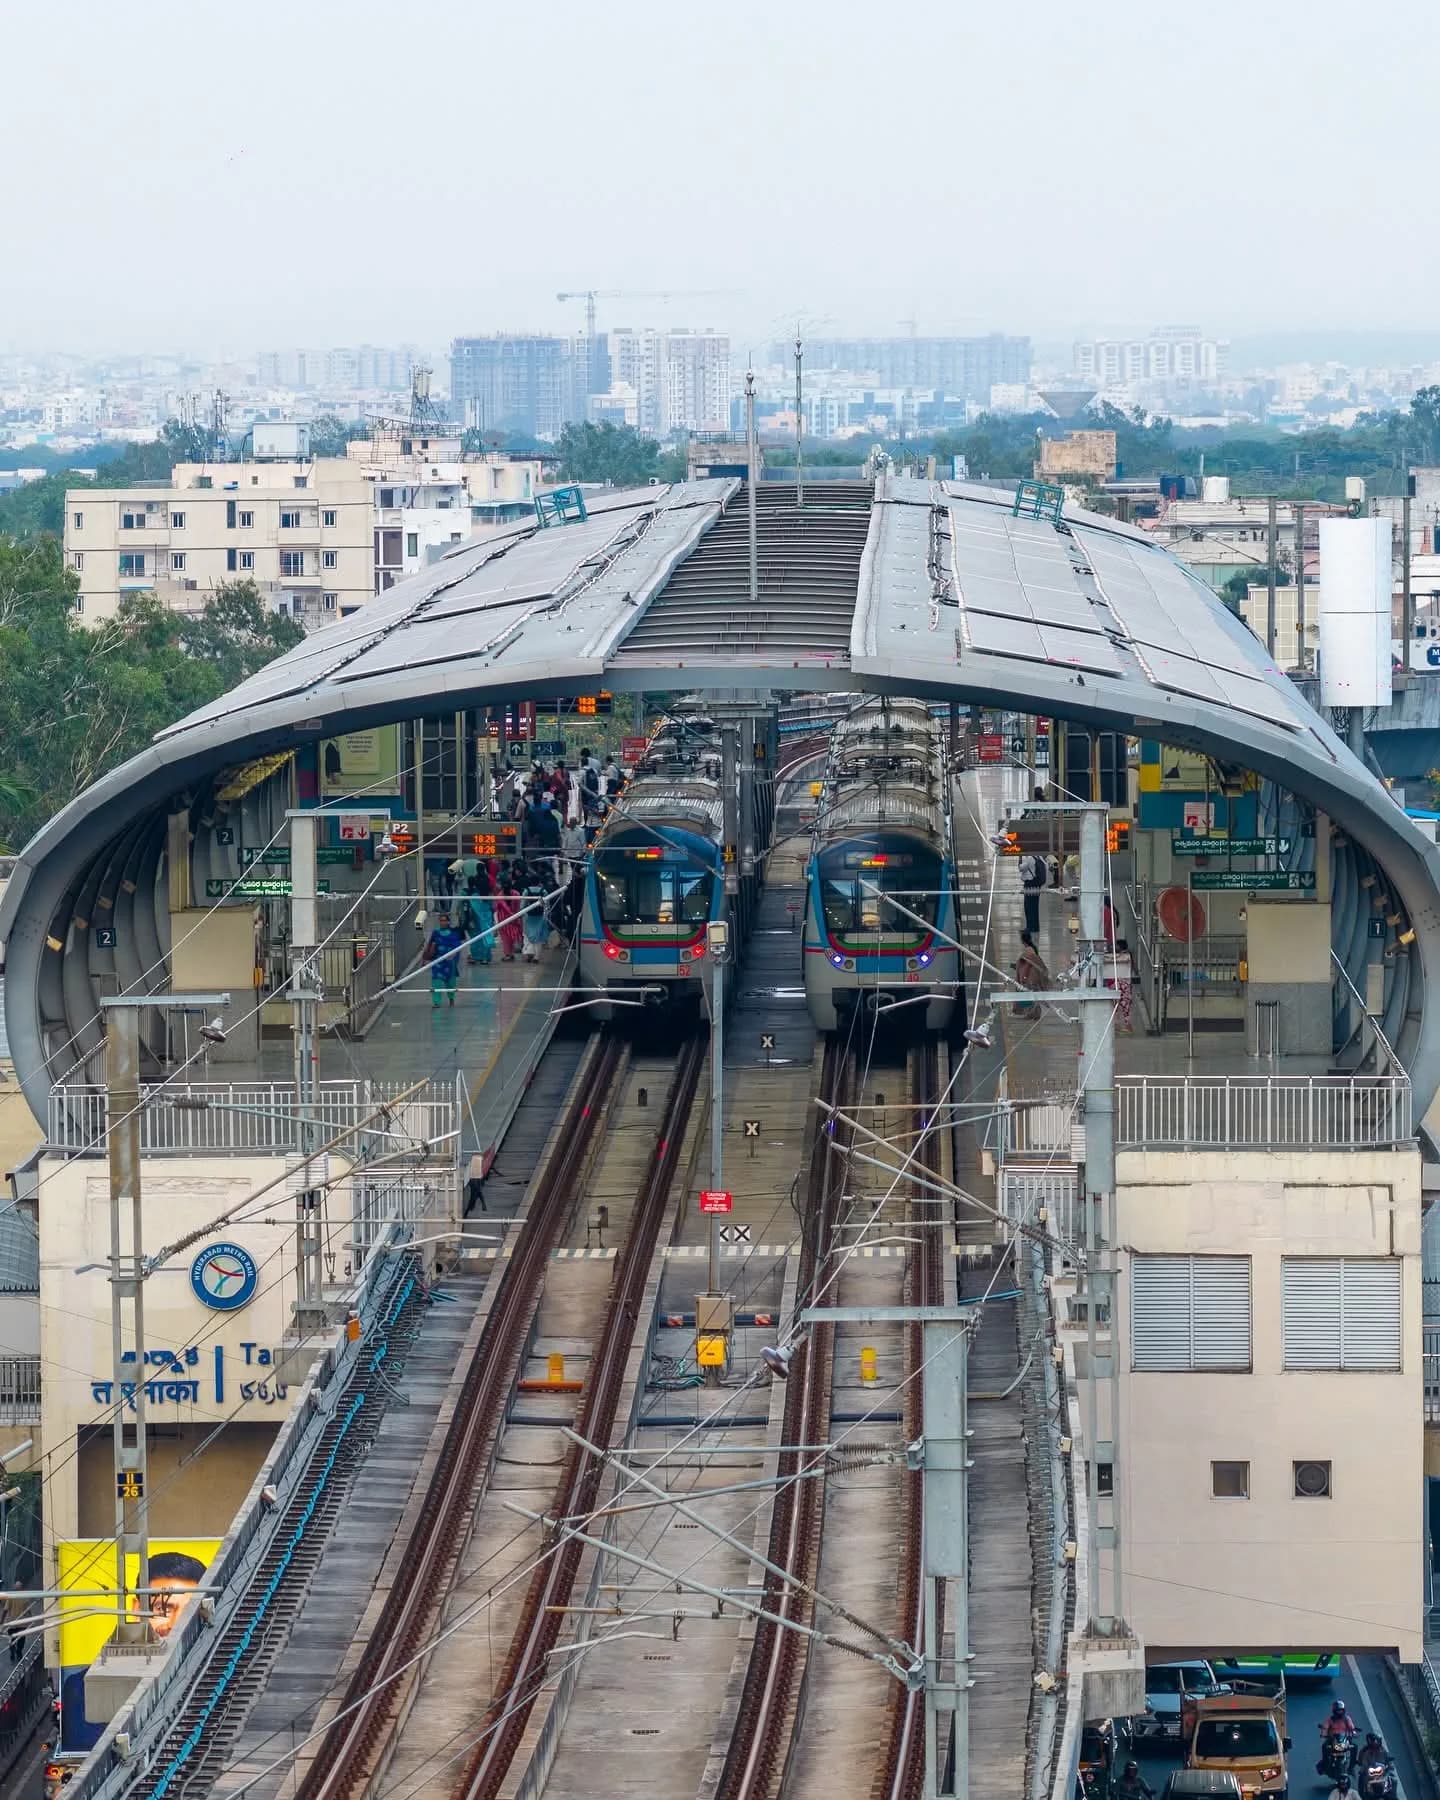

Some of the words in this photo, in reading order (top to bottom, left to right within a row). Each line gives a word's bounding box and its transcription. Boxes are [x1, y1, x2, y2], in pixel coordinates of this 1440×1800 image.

[392, 823, 409, 833] P2
[221, 831, 229, 842] 2
[102, 932, 111, 944] 2
[194, 1247, 222, 1280] HYDERABAD
[224, 1247, 246, 1262] METRO
[244, 1261, 254, 1277] RAIL
[123, 1486, 139, 1497] 26
